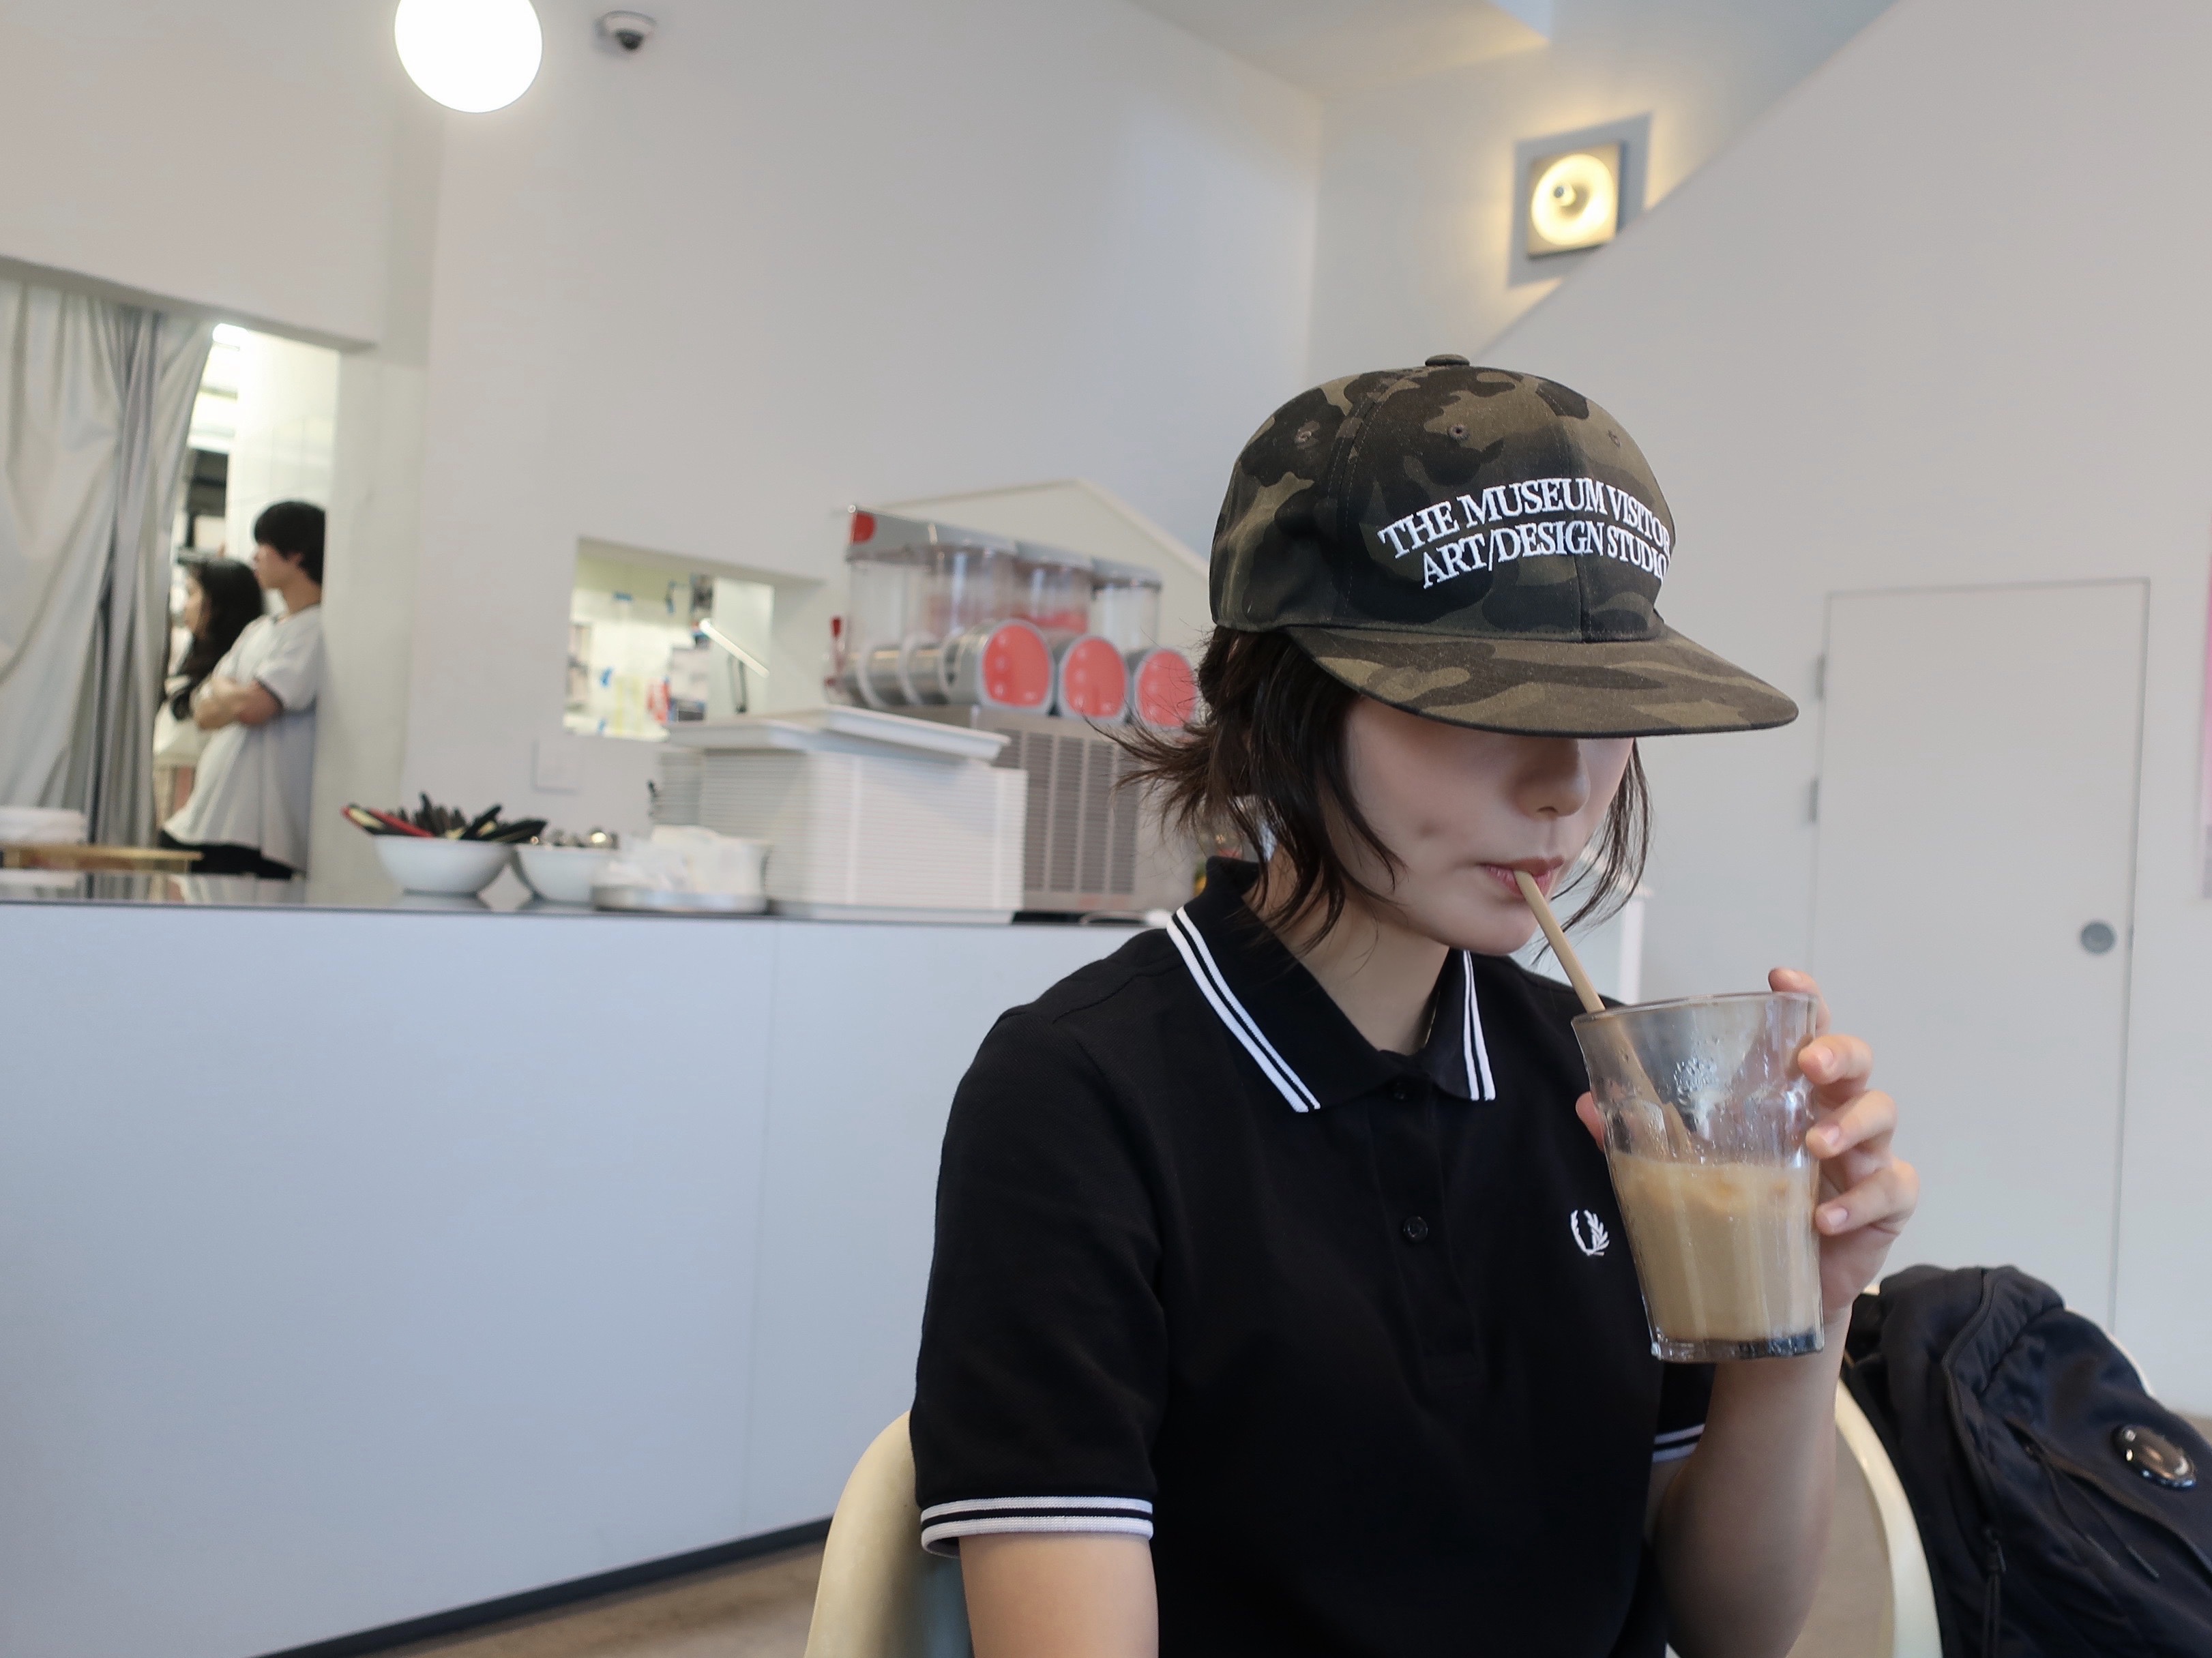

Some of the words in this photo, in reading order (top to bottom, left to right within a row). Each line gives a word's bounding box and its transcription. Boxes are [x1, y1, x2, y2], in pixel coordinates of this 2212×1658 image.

[1377, 501, 1460, 559] THE
[1456, 477, 1608, 529] MUSEUM
[1423, 520, 1605, 589] ART/DESIGN
[1607, 524, 1667, 584] STUDIO
